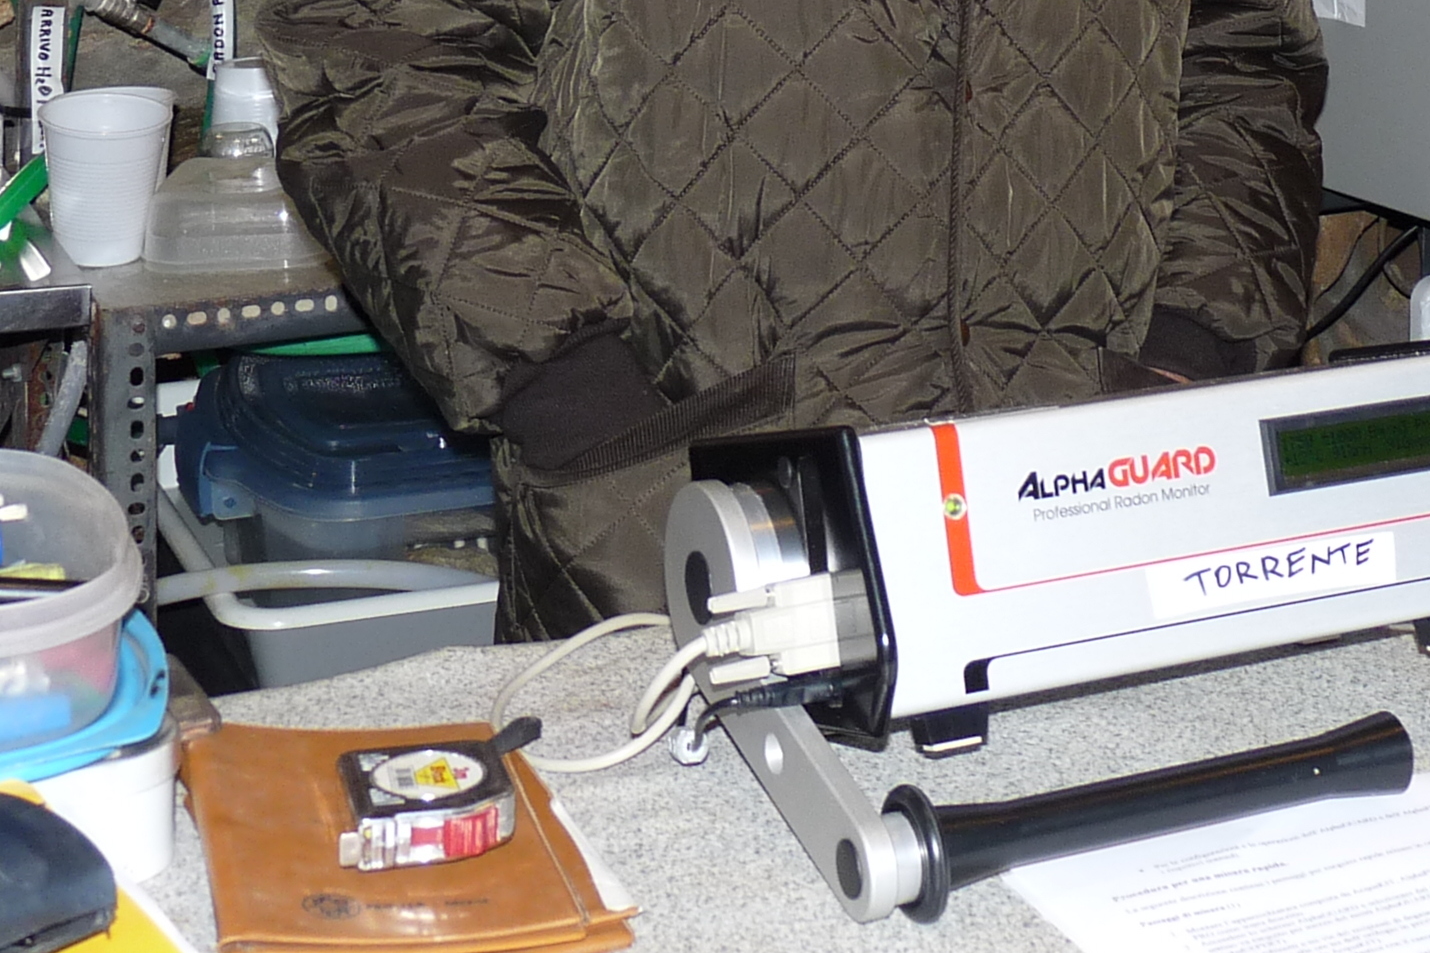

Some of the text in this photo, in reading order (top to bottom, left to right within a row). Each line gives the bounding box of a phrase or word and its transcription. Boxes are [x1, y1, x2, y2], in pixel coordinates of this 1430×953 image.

[38, 8, 54, 61] ARRIVO
[1033, 483, 1210, 522] Professional Radon Monitor
[1183, 538, 1374, 596] TORRENTE
